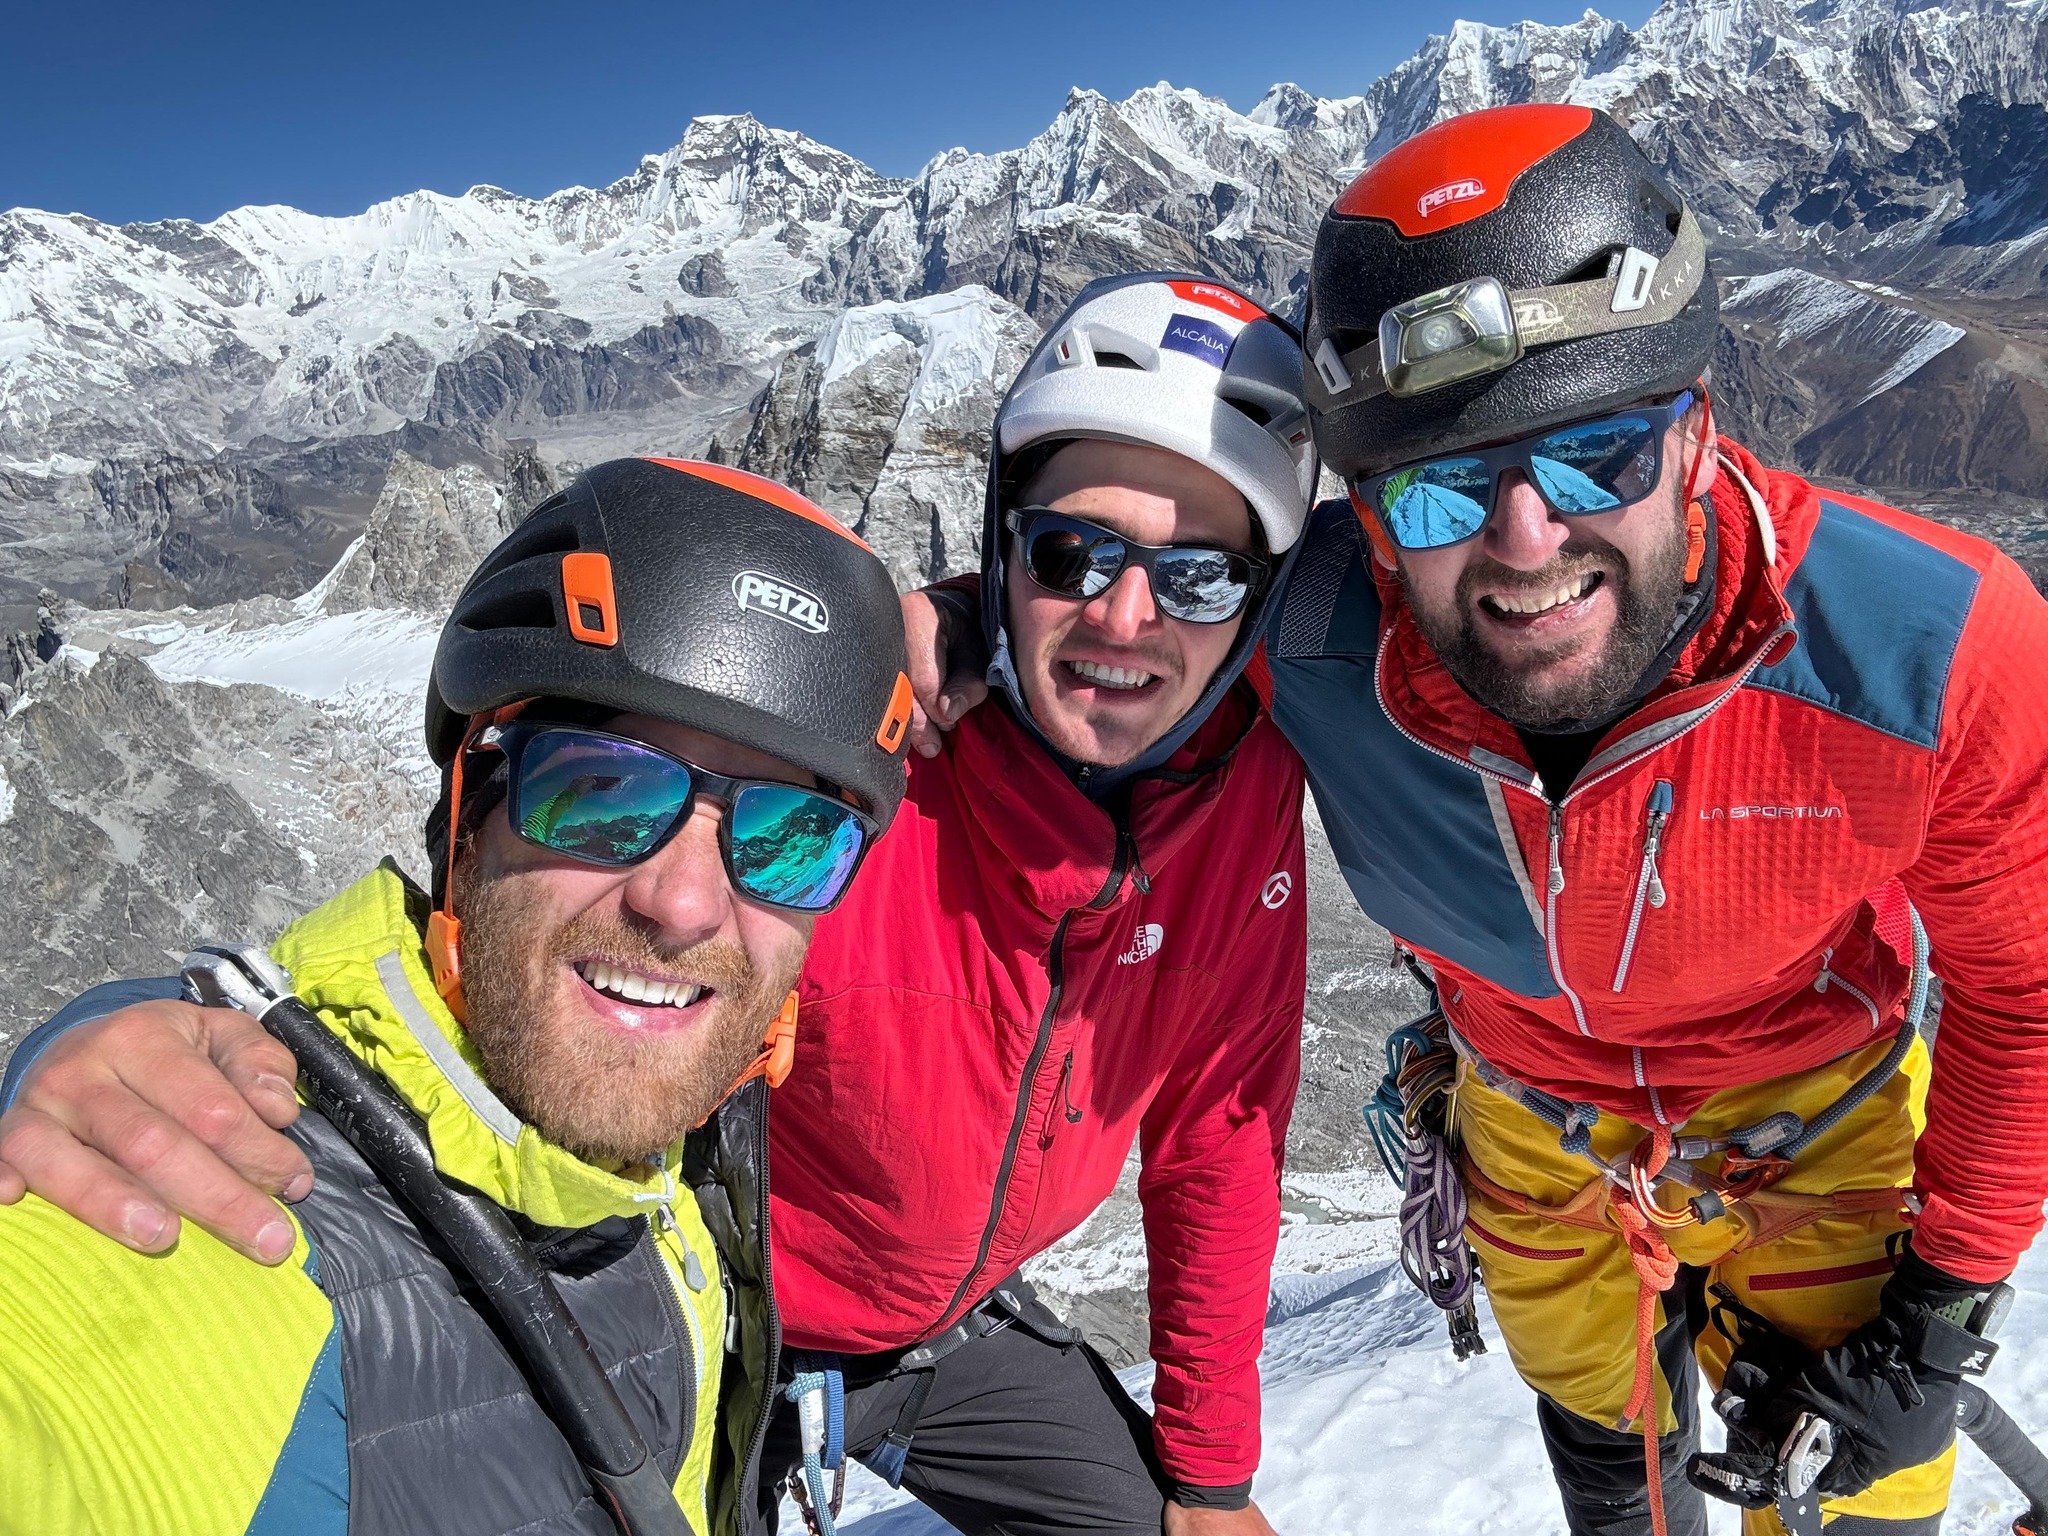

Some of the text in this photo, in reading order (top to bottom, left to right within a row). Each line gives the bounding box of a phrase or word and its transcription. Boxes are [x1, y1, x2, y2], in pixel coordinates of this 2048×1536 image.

[1419, 181, 1486, 217] PETZL
[1192, 285, 1241, 309] PETZL
[1648, 260, 1693, 306] IKKA
[1171, 327, 1225, 354] ALCALIA
[738, 574, 829, 633] PETZL
[1700, 805, 1842, 820] LA SPORTIVA
